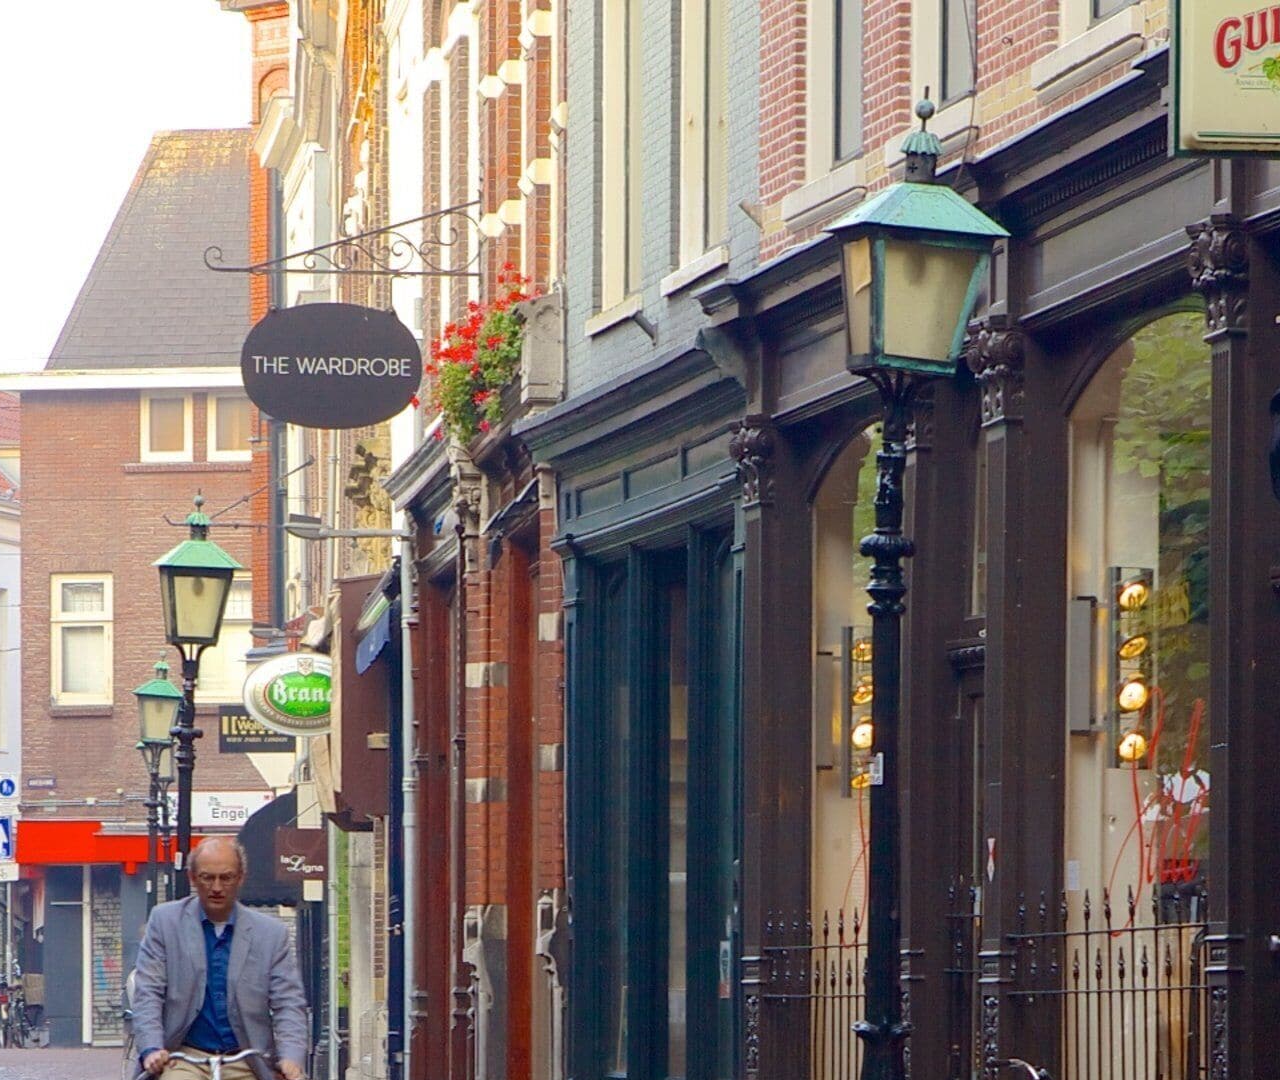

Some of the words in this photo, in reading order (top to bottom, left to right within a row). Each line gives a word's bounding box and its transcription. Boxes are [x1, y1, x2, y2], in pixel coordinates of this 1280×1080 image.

[252, 356, 290, 375] THE
[297, 356, 412, 378] WARDROBE
[211, 807, 249, 821] Engel
